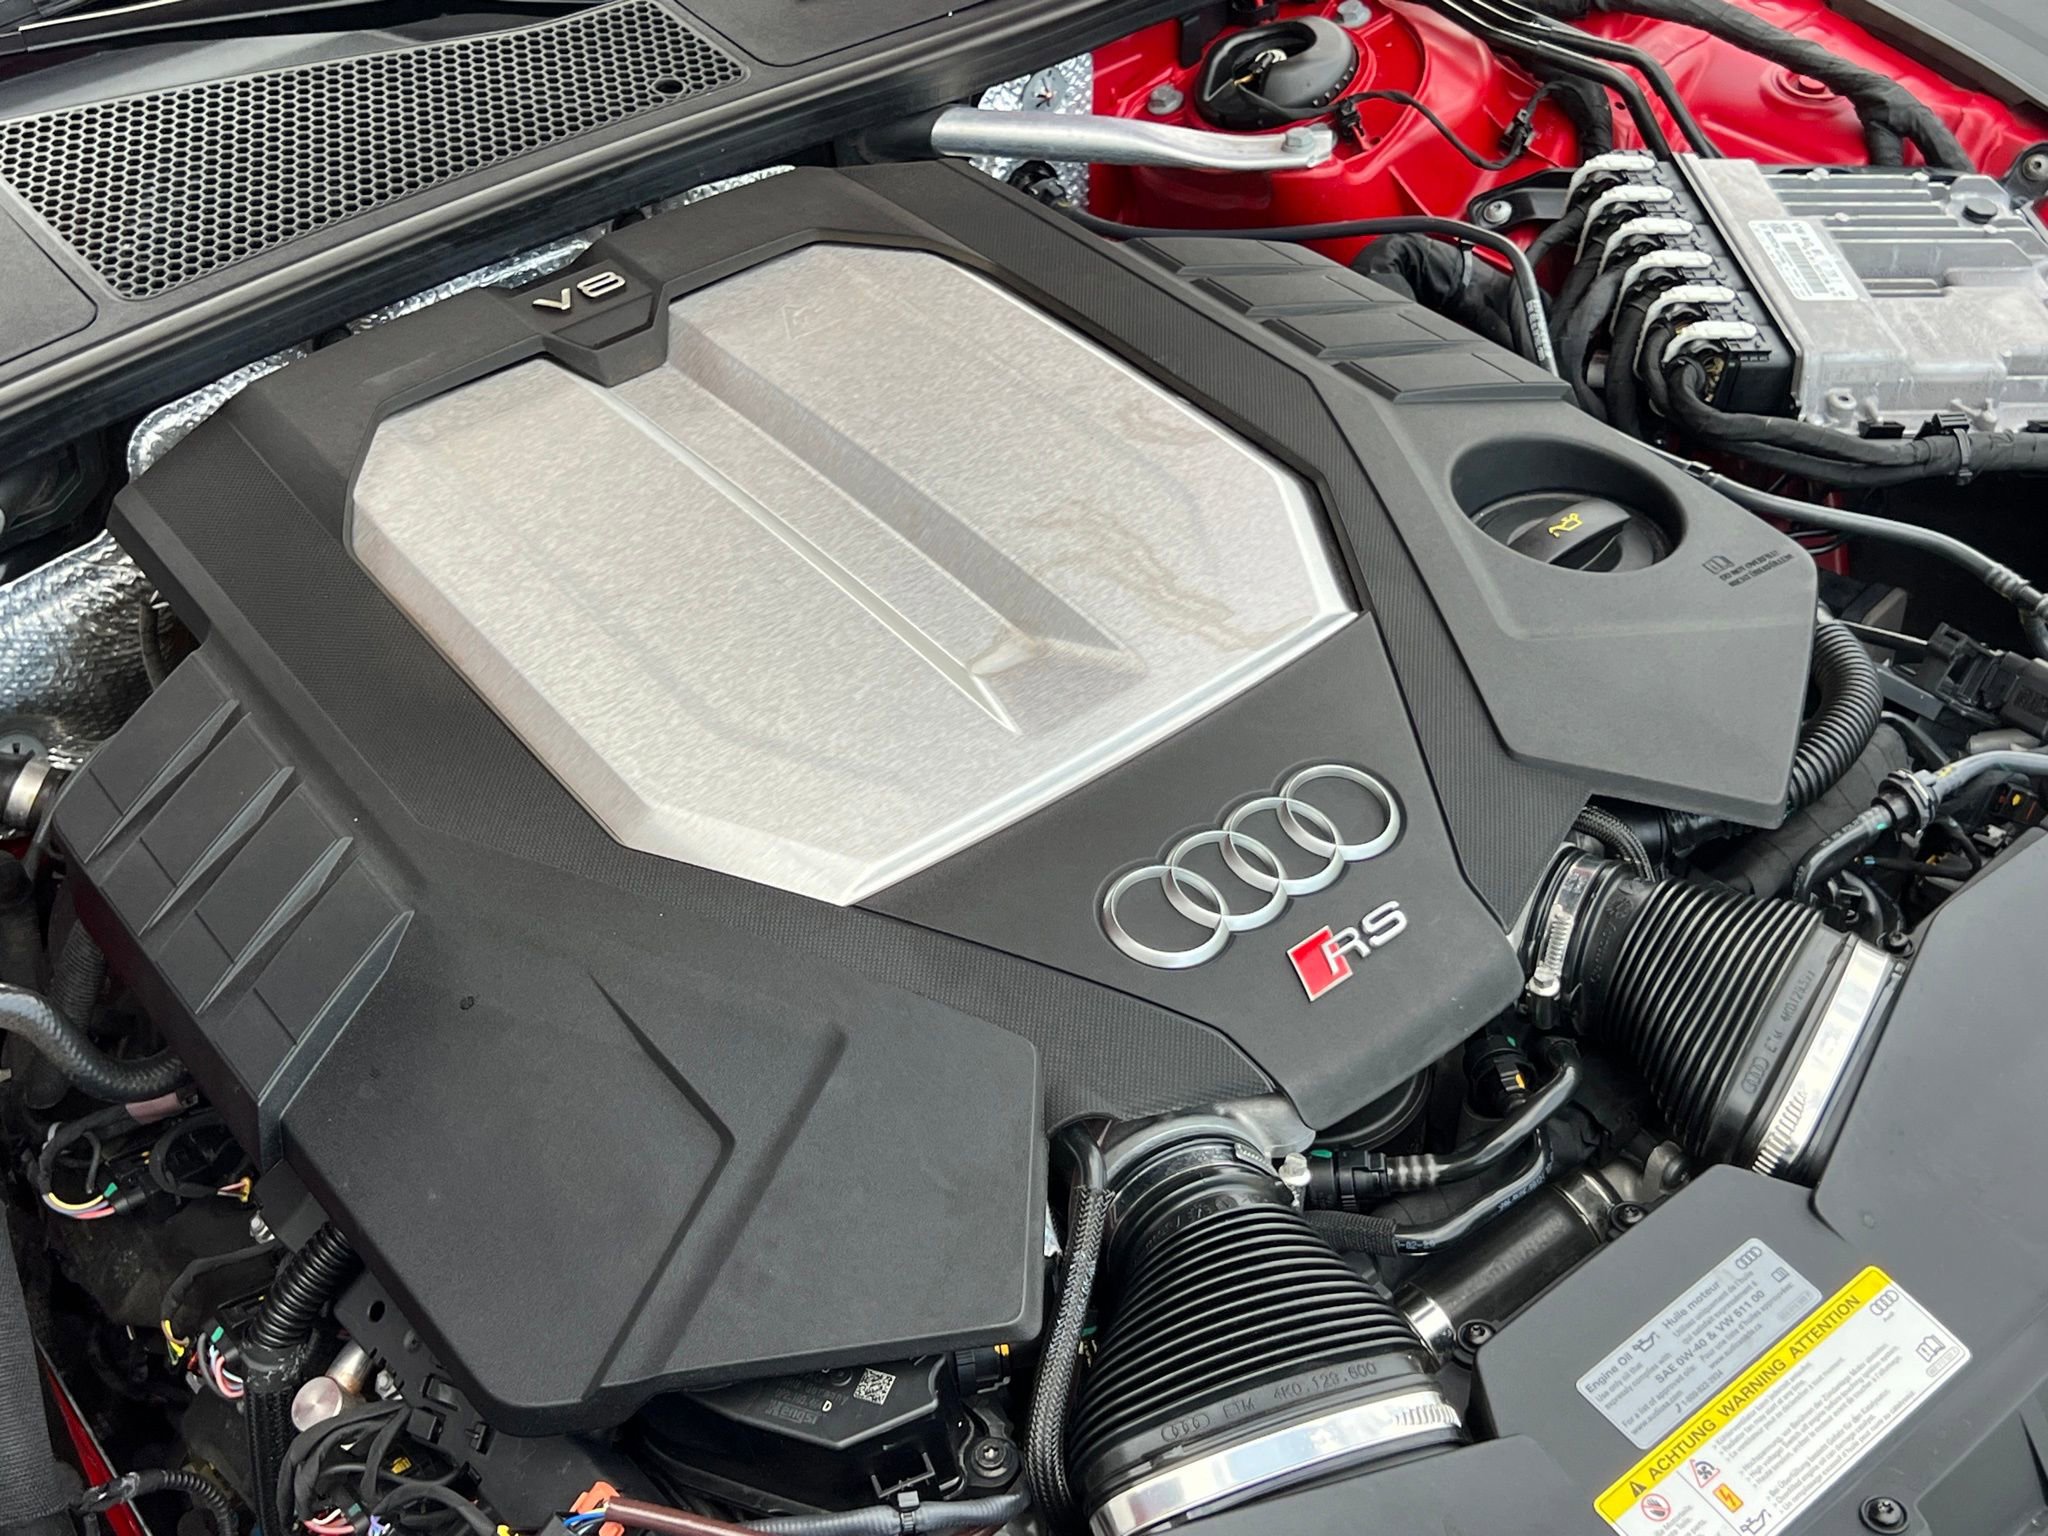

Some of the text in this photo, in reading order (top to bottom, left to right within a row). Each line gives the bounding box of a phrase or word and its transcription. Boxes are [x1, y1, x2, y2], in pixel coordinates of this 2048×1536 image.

[532, 271, 626, 311] V8
[1322, 901, 1408, 976] RS
[1661, 1280, 1721, 1329] Huile moteur
[1654, 1289, 1765, 1383] SAE 0W-40 & VW 511 00
[1584, 1352, 1633, 1394] Engine Oil
[1646, 1417, 1717, 1481] ACHTUNG
[1716, 1356, 1787, 1419] WARNING
[1785, 1293, 1860, 1359] ATTENTION
[821, 1399, 833, 1412] D
